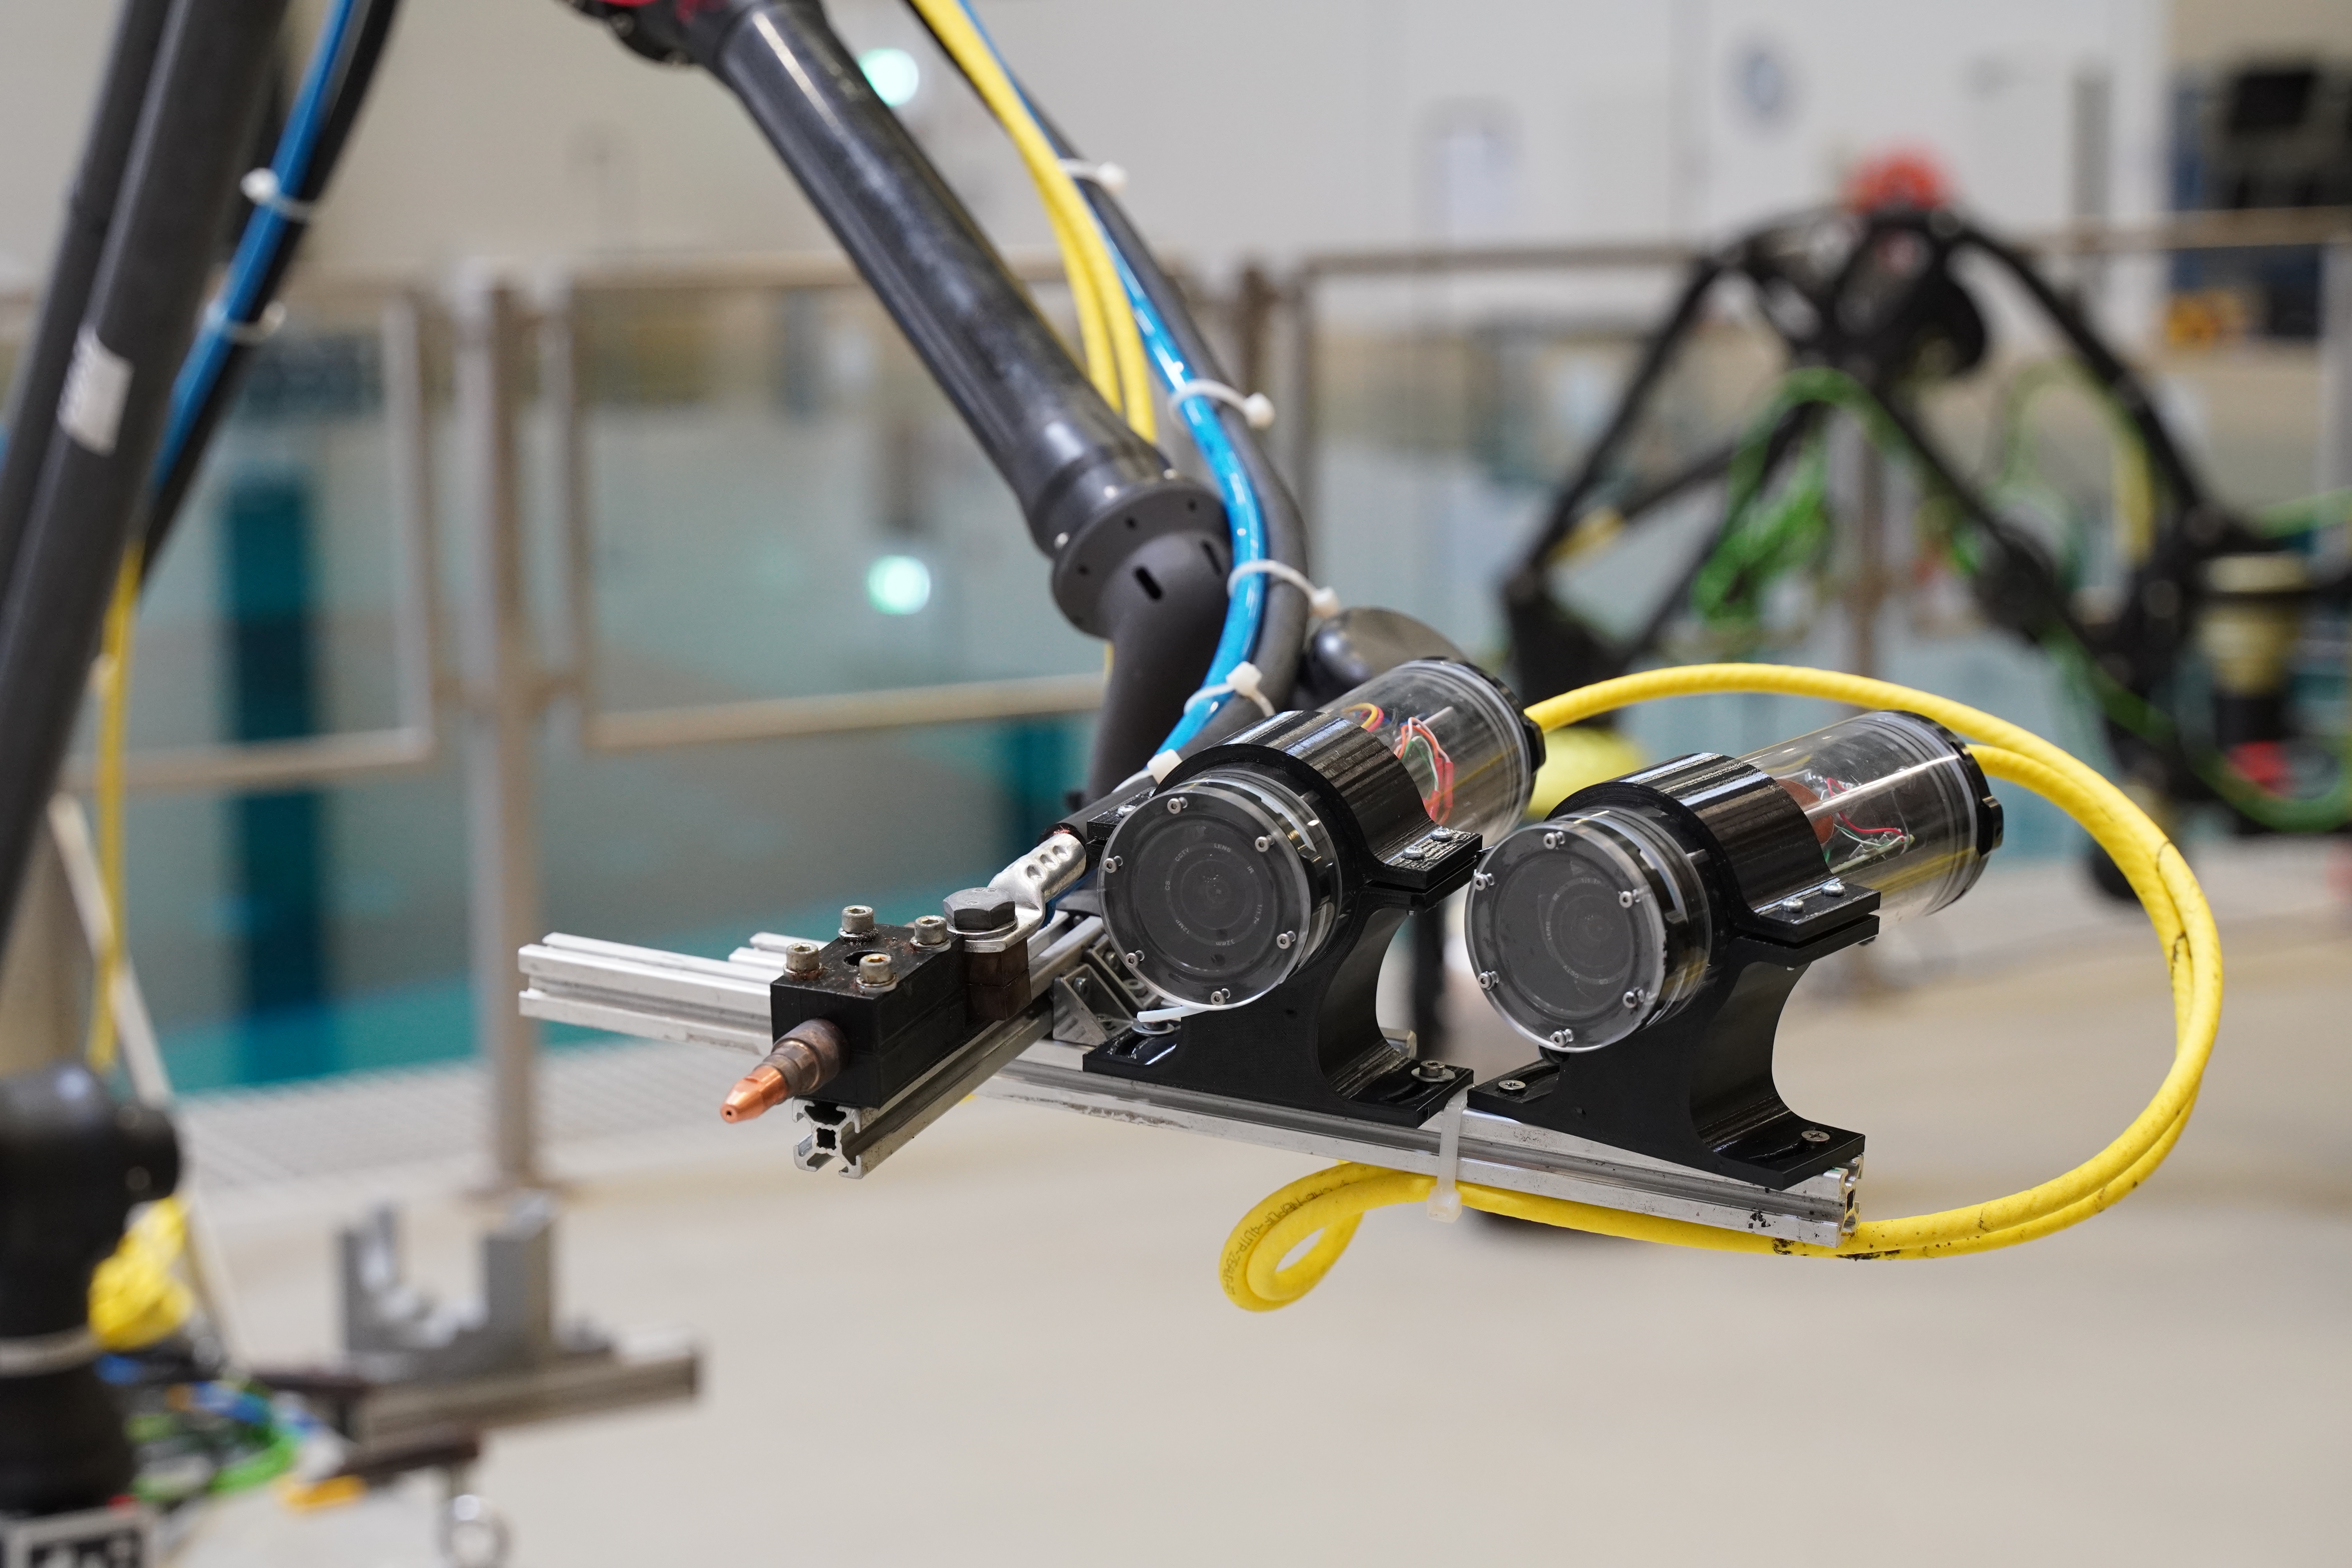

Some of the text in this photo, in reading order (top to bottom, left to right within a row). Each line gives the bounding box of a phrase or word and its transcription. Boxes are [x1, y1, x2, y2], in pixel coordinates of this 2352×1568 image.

[1214, 843, 1231, 853] LENS
[1175, 848, 1189, 862] CCTV
[1247, 866, 1254, 874] IR
[1165, 880, 1170, 890] CS
[1175, 919, 1189, 934] 12MP
